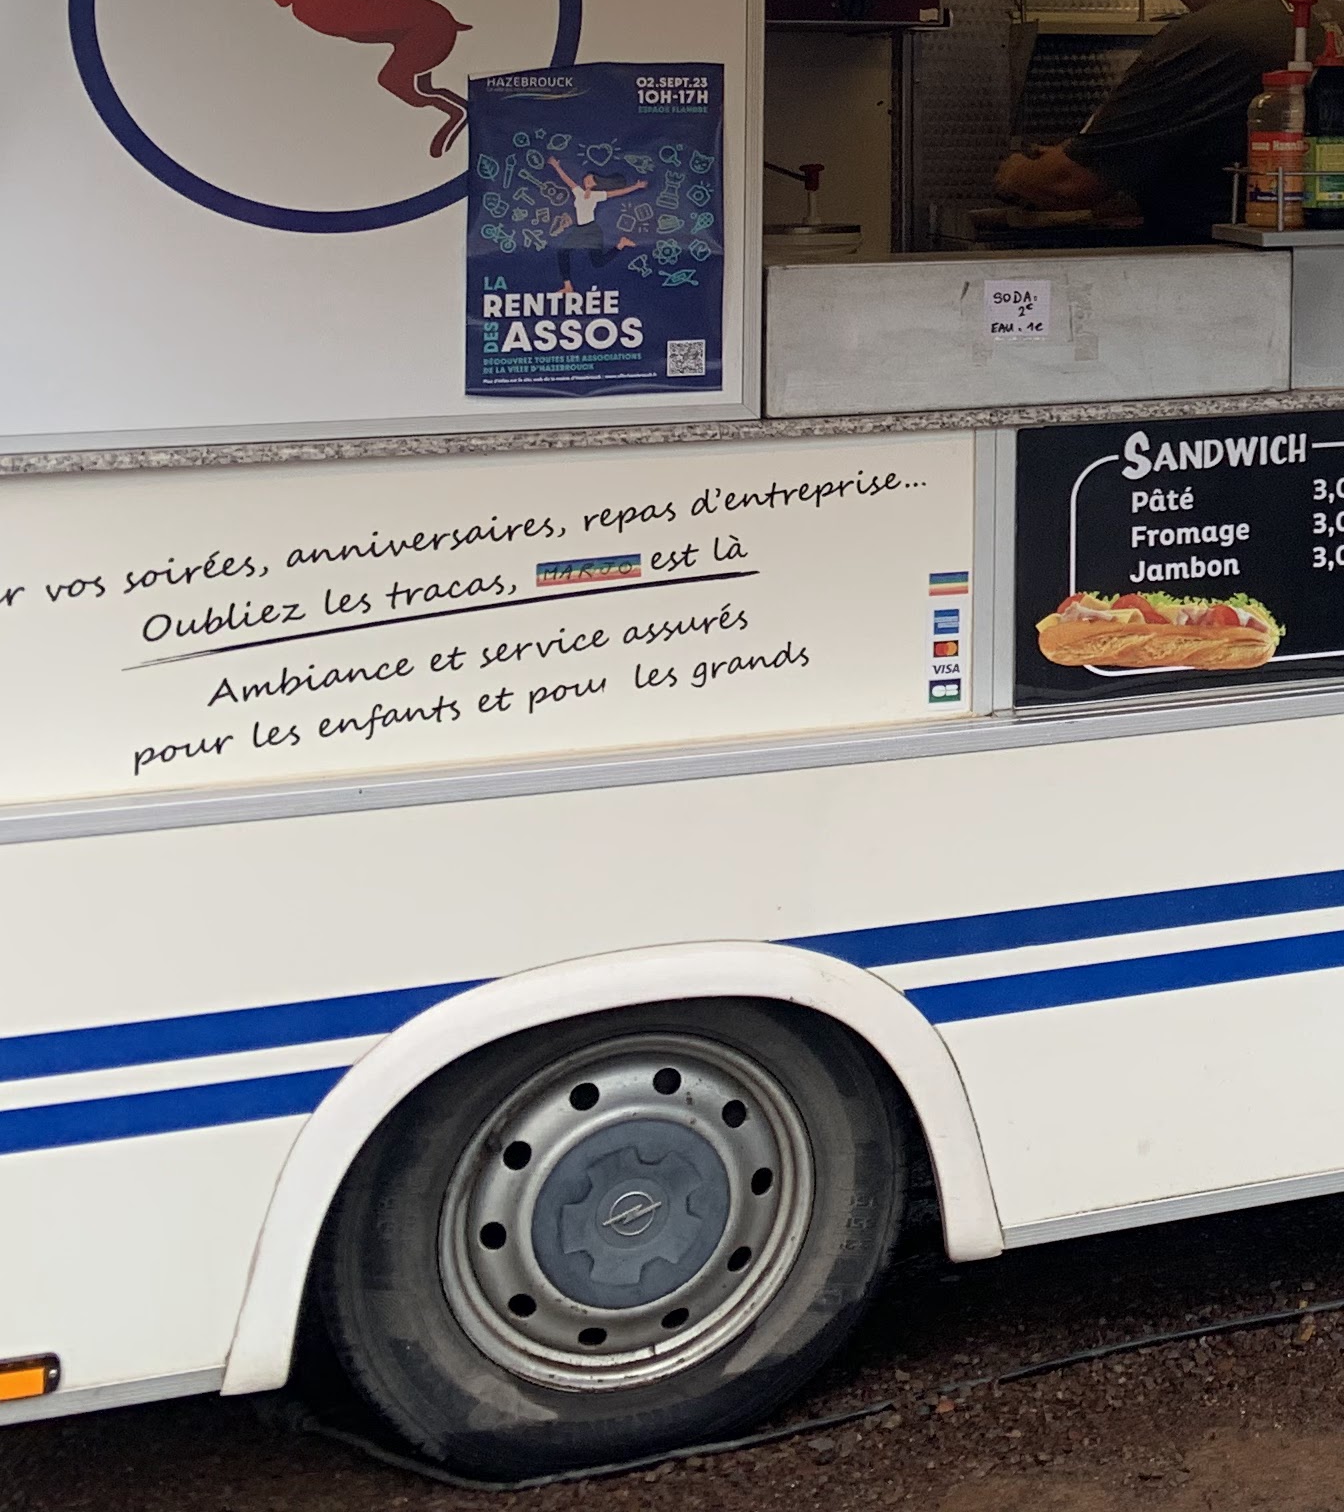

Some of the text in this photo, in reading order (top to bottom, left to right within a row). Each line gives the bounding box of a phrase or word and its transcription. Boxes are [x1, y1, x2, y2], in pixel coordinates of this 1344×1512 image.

[487, 77, 573, 88] HAZEBROUCK
[636, 76, 708, 88] 02.SEPT.23
[637, 90, 709, 104] 10H-17H
[483, 276, 508, 291] LA
[483, 285, 619, 318] RENTRÉE
[483, 321, 499, 354] DES
[501, 317, 644, 353] ASSOS
[1131, 486, 1195, 513] Pâté
[1131, 522, 1251, 549] Fromage
[46, 576, 106, 603] vos
[123, 550, 270, 595] soirées,
[286, 516, 566, 569] anniversaires,
[584, 501, 677, 533] repas
[1129, 556, 1241, 584] Jambon
[142, 534, 748, 643] Oubliez les tracas, MARJO est là
[207, 603, 749, 707] Ambiance et service assurés
[932, 663, 960, 675] VISA
[133, 734, 234, 776] pour
[252, 721, 301, 748] les
[318, 695, 462, 740] enfants
[478, 687, 514, 714] et
[634, 662, 678, 690] les
[691, 641, 811, 688] grands
